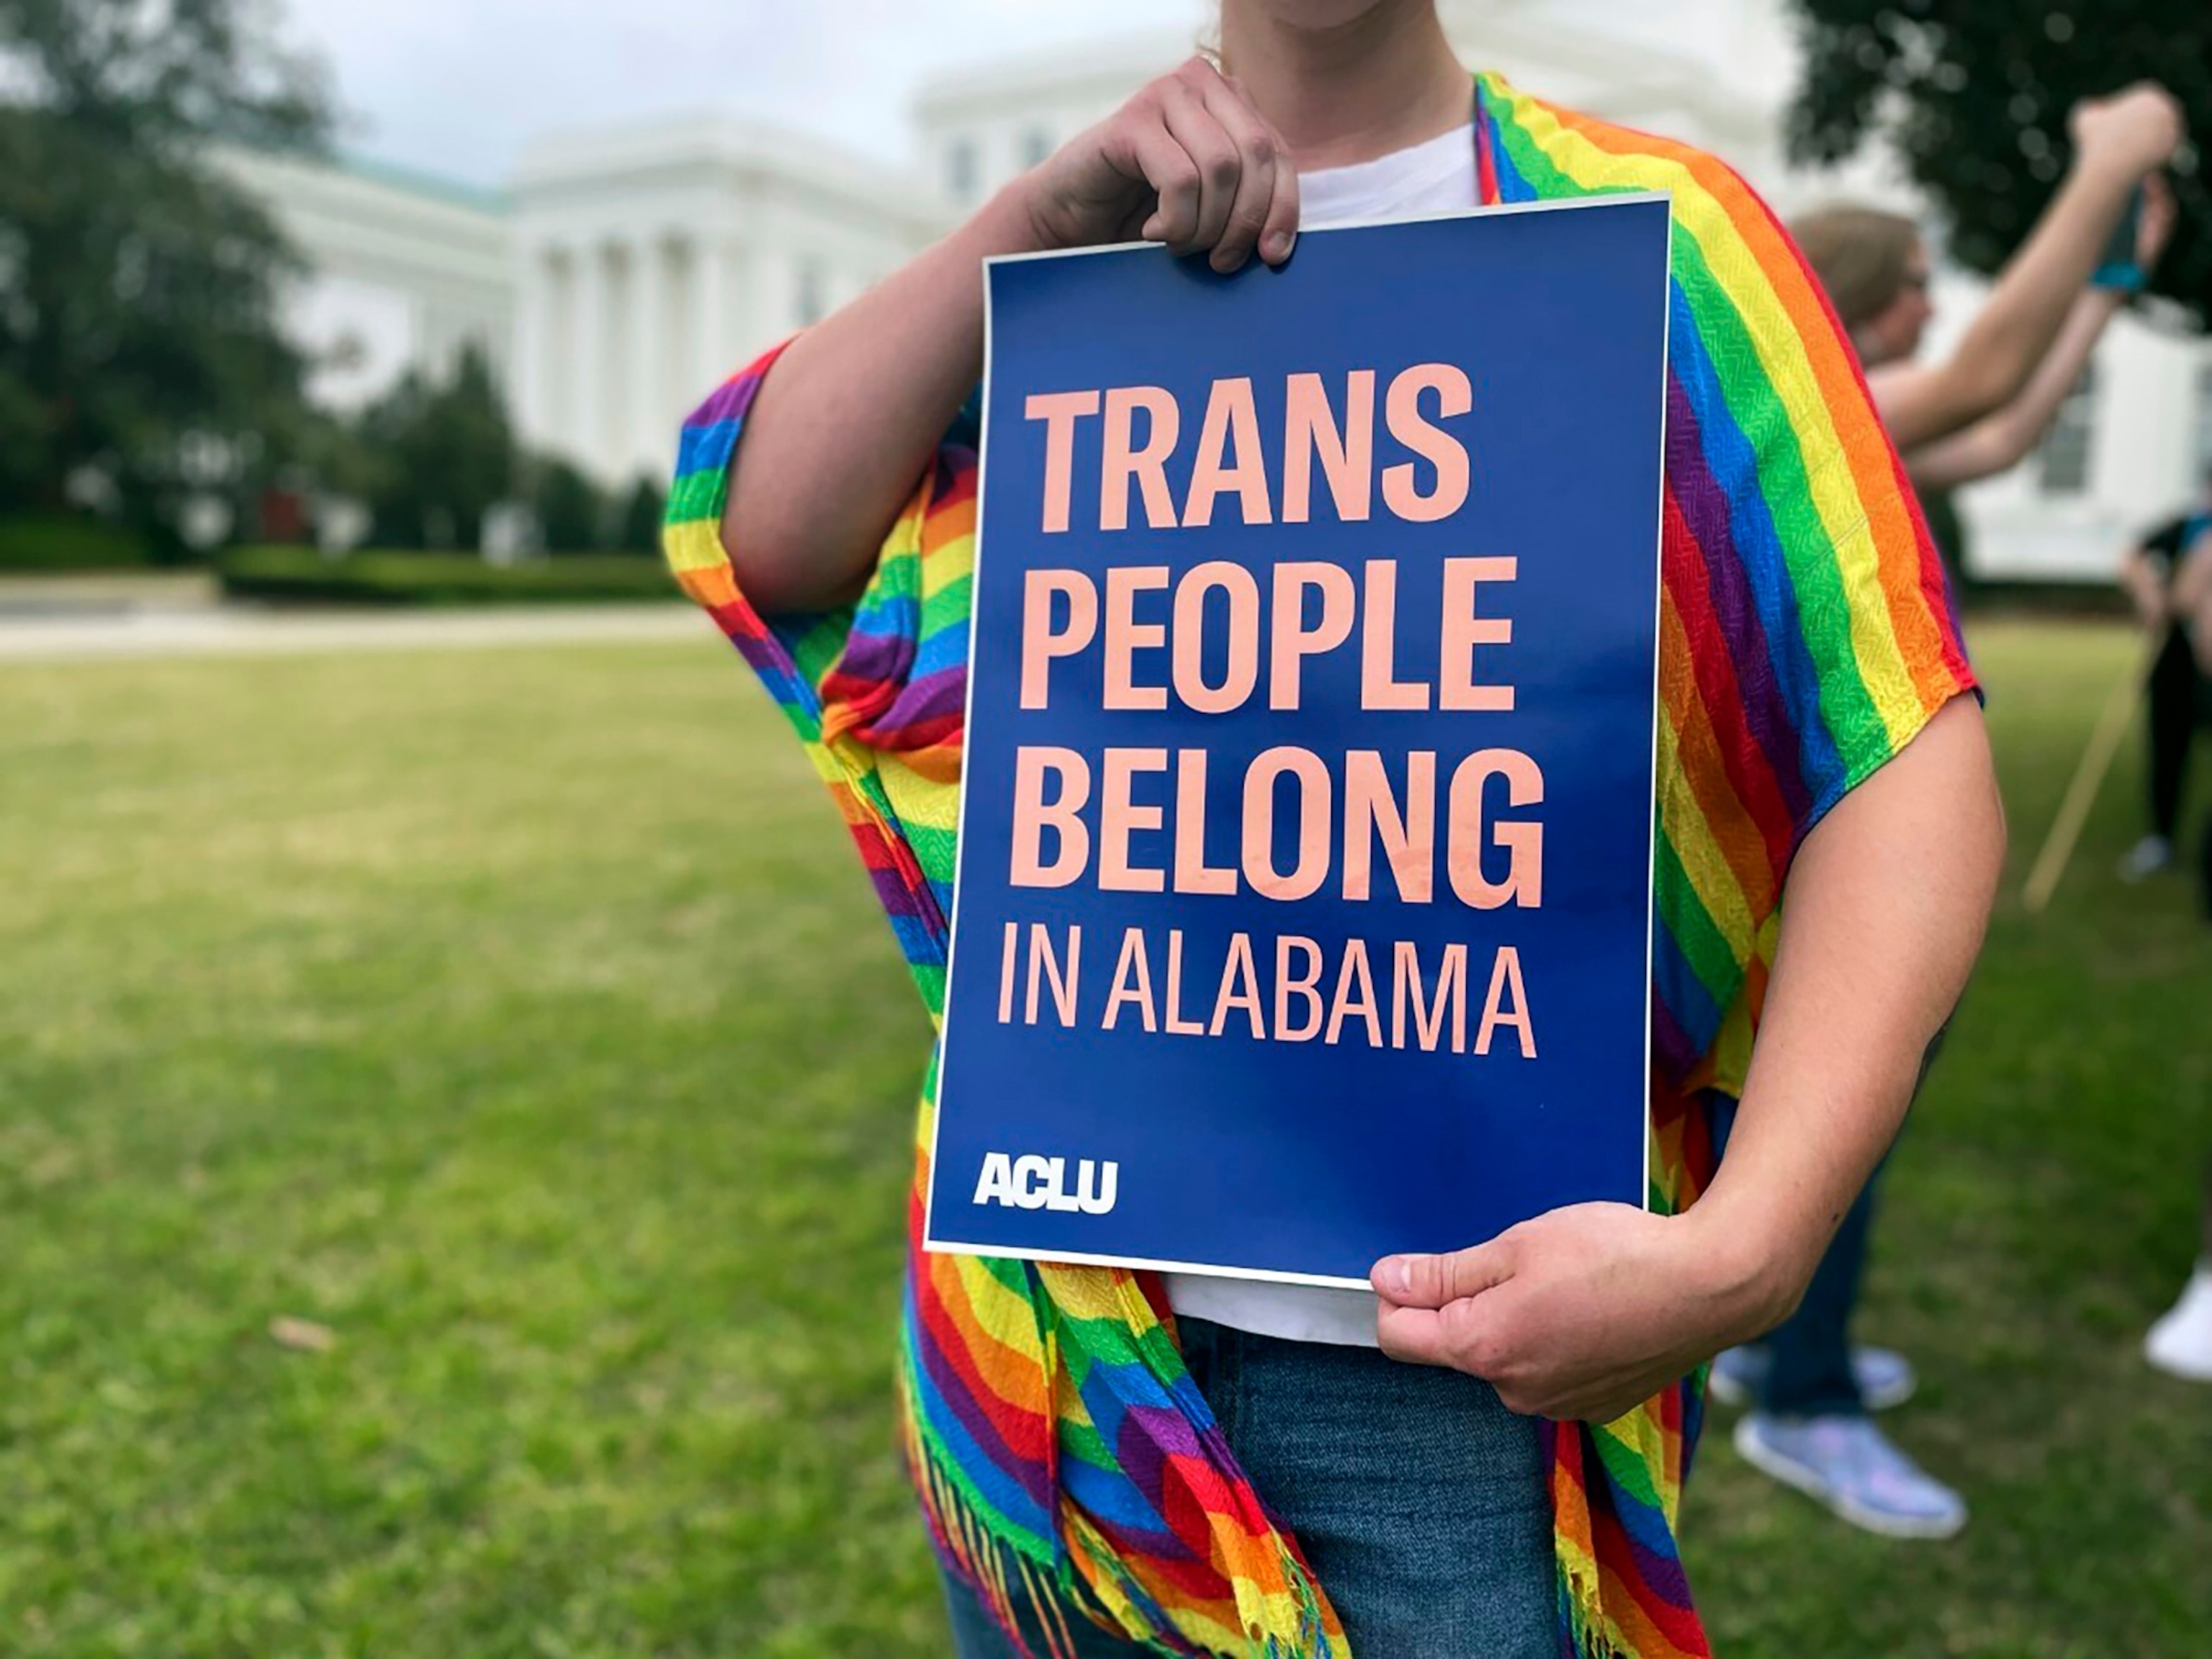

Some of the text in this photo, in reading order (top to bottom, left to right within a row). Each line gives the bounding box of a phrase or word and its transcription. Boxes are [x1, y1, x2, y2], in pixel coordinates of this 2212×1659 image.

[1025, 364, 1472, 532] TRANS
[1020, 557, 1517, 711] PEOPLE
[1010, 747, 1544, 909] BELONG
[998, 922, 1537, 1058] IN ALABAMA
[974, 1152, 1118, 1214] ACLU
